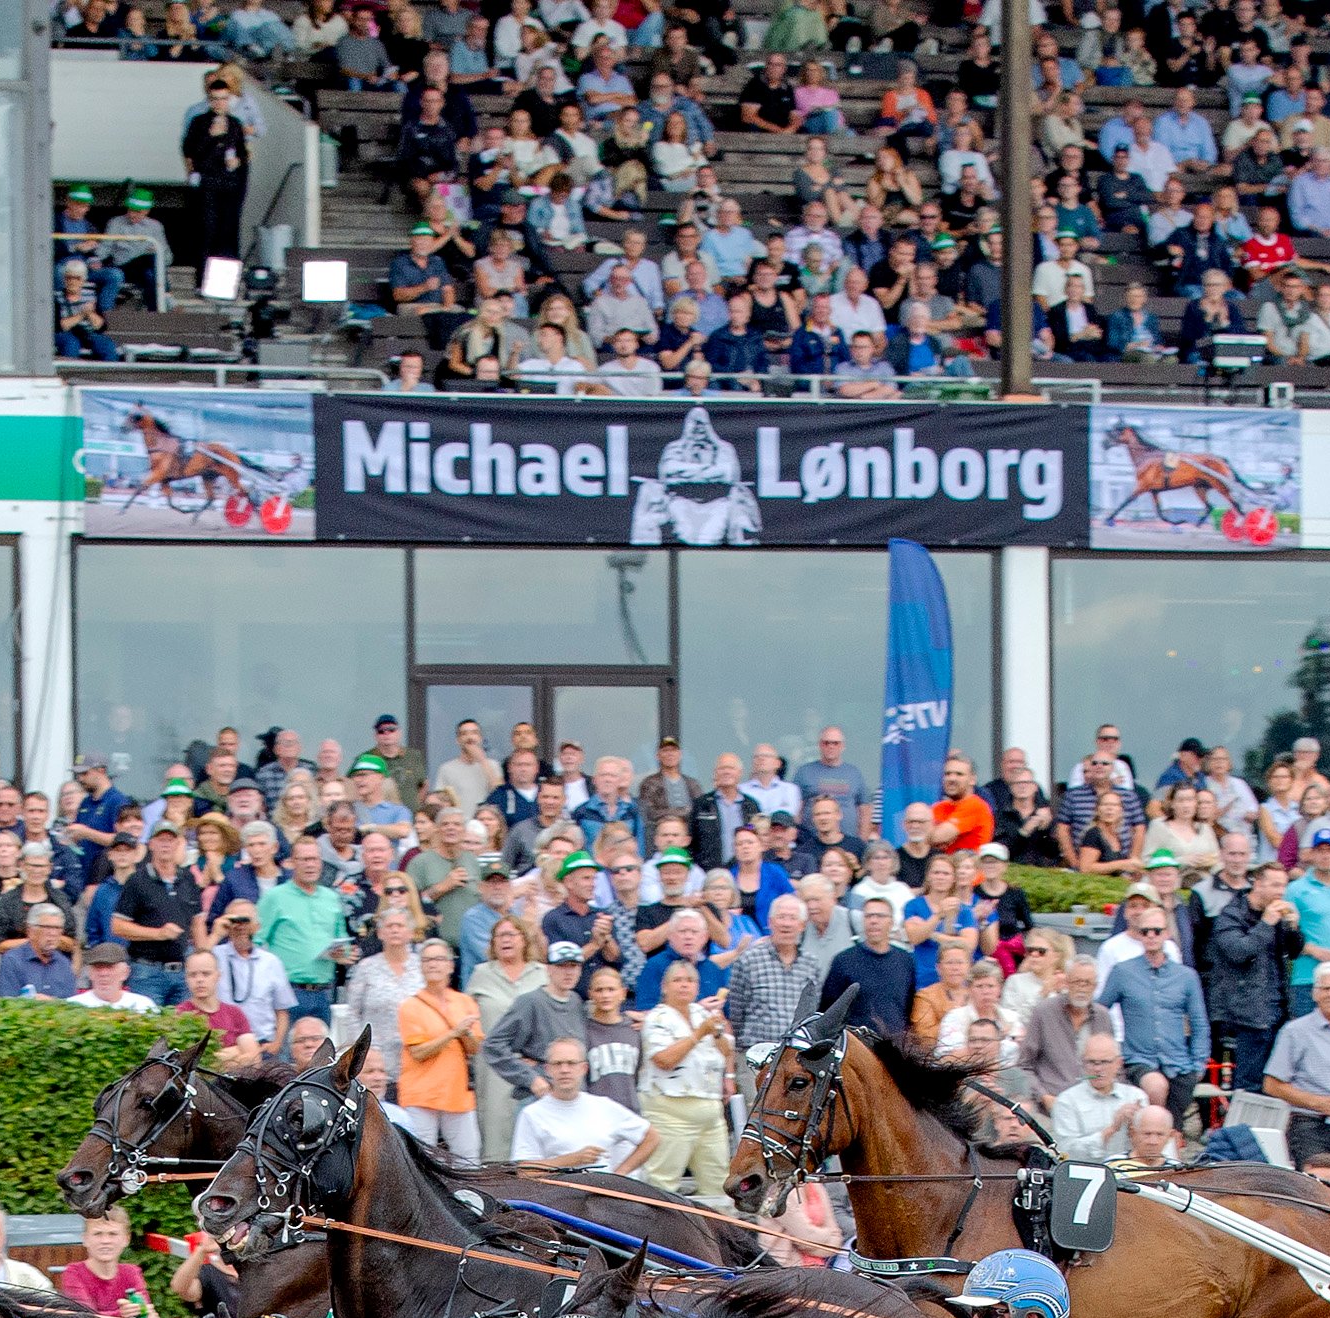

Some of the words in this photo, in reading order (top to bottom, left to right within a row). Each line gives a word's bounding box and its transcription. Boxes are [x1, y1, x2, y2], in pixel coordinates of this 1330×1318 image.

[344, 420, 628, 495] Michael
[759, 426, 1063, 519] Lønborg
[1069, 1164, 1106, 1225] 7
